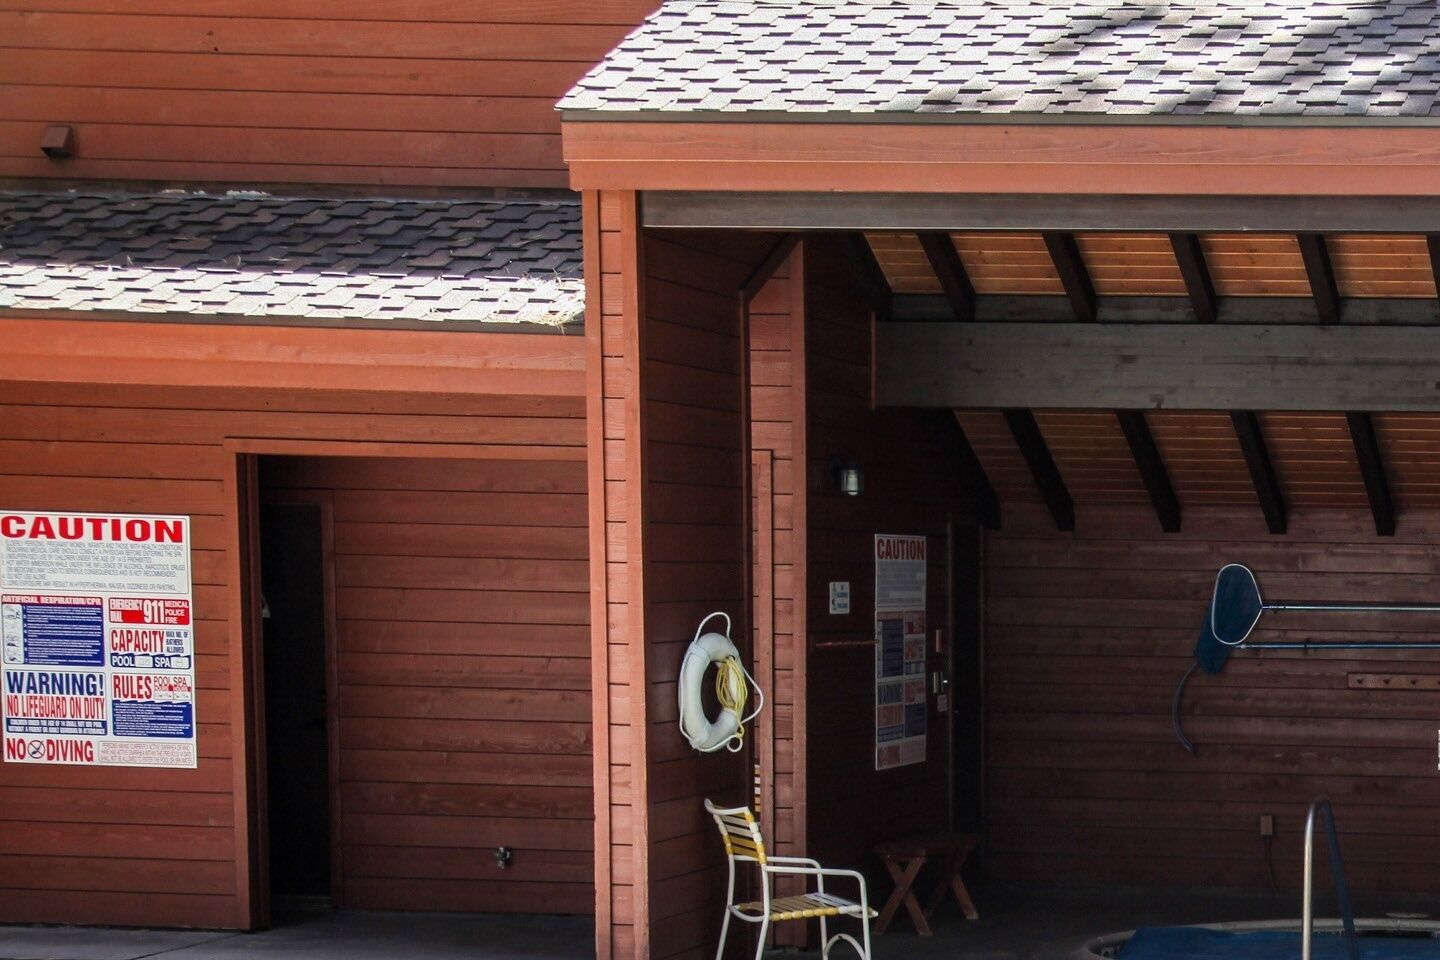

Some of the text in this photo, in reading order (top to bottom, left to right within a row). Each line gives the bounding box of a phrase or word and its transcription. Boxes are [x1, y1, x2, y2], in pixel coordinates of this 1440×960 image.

[1, 515, 183, 543] CAUTION
[877, 538, 925, 560] CAUTION
[2, 595, 102, 606] ARTIFICIAL RESPIRATION/CPR
[110, 598, 143, 610] EMERGENCY
[165, 600, 188, 608] MEDICAL
[110, 611, 123, 622] DIAL
[143, 600, 165, 624] 911
[165, 608, 186, 616] POLICE
[111, 630, 164, 652] CAPACITY
[112, 656, 134, 667] POOL
[154, 656, 172, 668] SPA
[6, 672, 104, 696] WARNING!
[113, 675, 152, 699] RULES
[154, 676, 170, 687] POOL
[173, 676, 188, 688] SPA
[7, 694, 19, 717] NO
[22, 695, 67, 718] LIFEGUARD
[70, 697, 82, 719] ON
[84, 698, 105, 720] DUTY
[6, 738, 94, 762] NO DIVING
